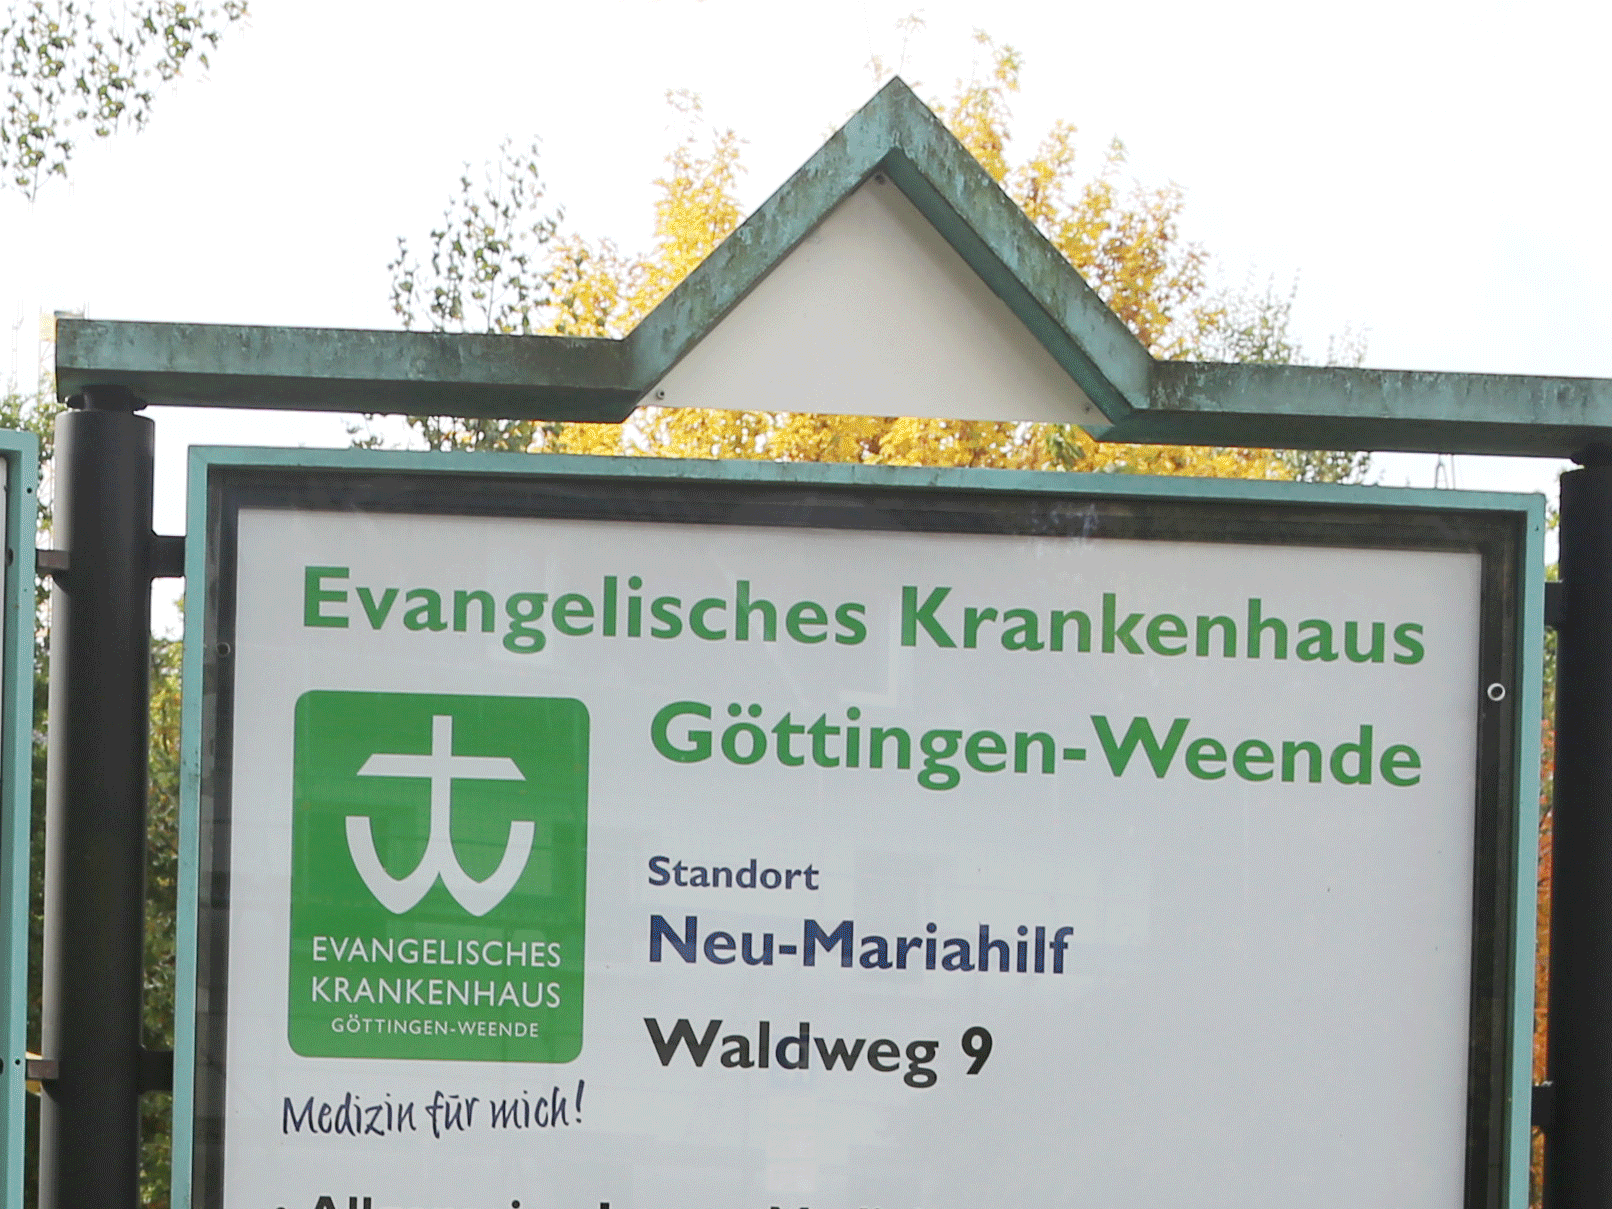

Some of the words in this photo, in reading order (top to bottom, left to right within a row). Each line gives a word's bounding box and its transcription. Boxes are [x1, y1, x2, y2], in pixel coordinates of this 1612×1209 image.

[302, 565, 868, 653] Evangelisches
[900, 584, 1426, 665] Krankenhaus
[649, 701, 1423, 791] Göttingen-Weende
[647, 855, 820, 891] Standort
[311, 936, 562, 968] EVANGELISCHES
[648, 914, 1074, 974] Neu-Mariahilf
[310, 977, 561, 1008] KRANKENHAUS
[330, 1013, 540, 1038] GÖTTINGEN-WEENDE
[644, 1018, 939, 1089] Waldweg
[961, 1025, 994, 1076] 9
[282, 1092, 417, 1138] Medizin
[425, 1090, 479, 1139] für
[489, 1079, 586, 1128] mich!
